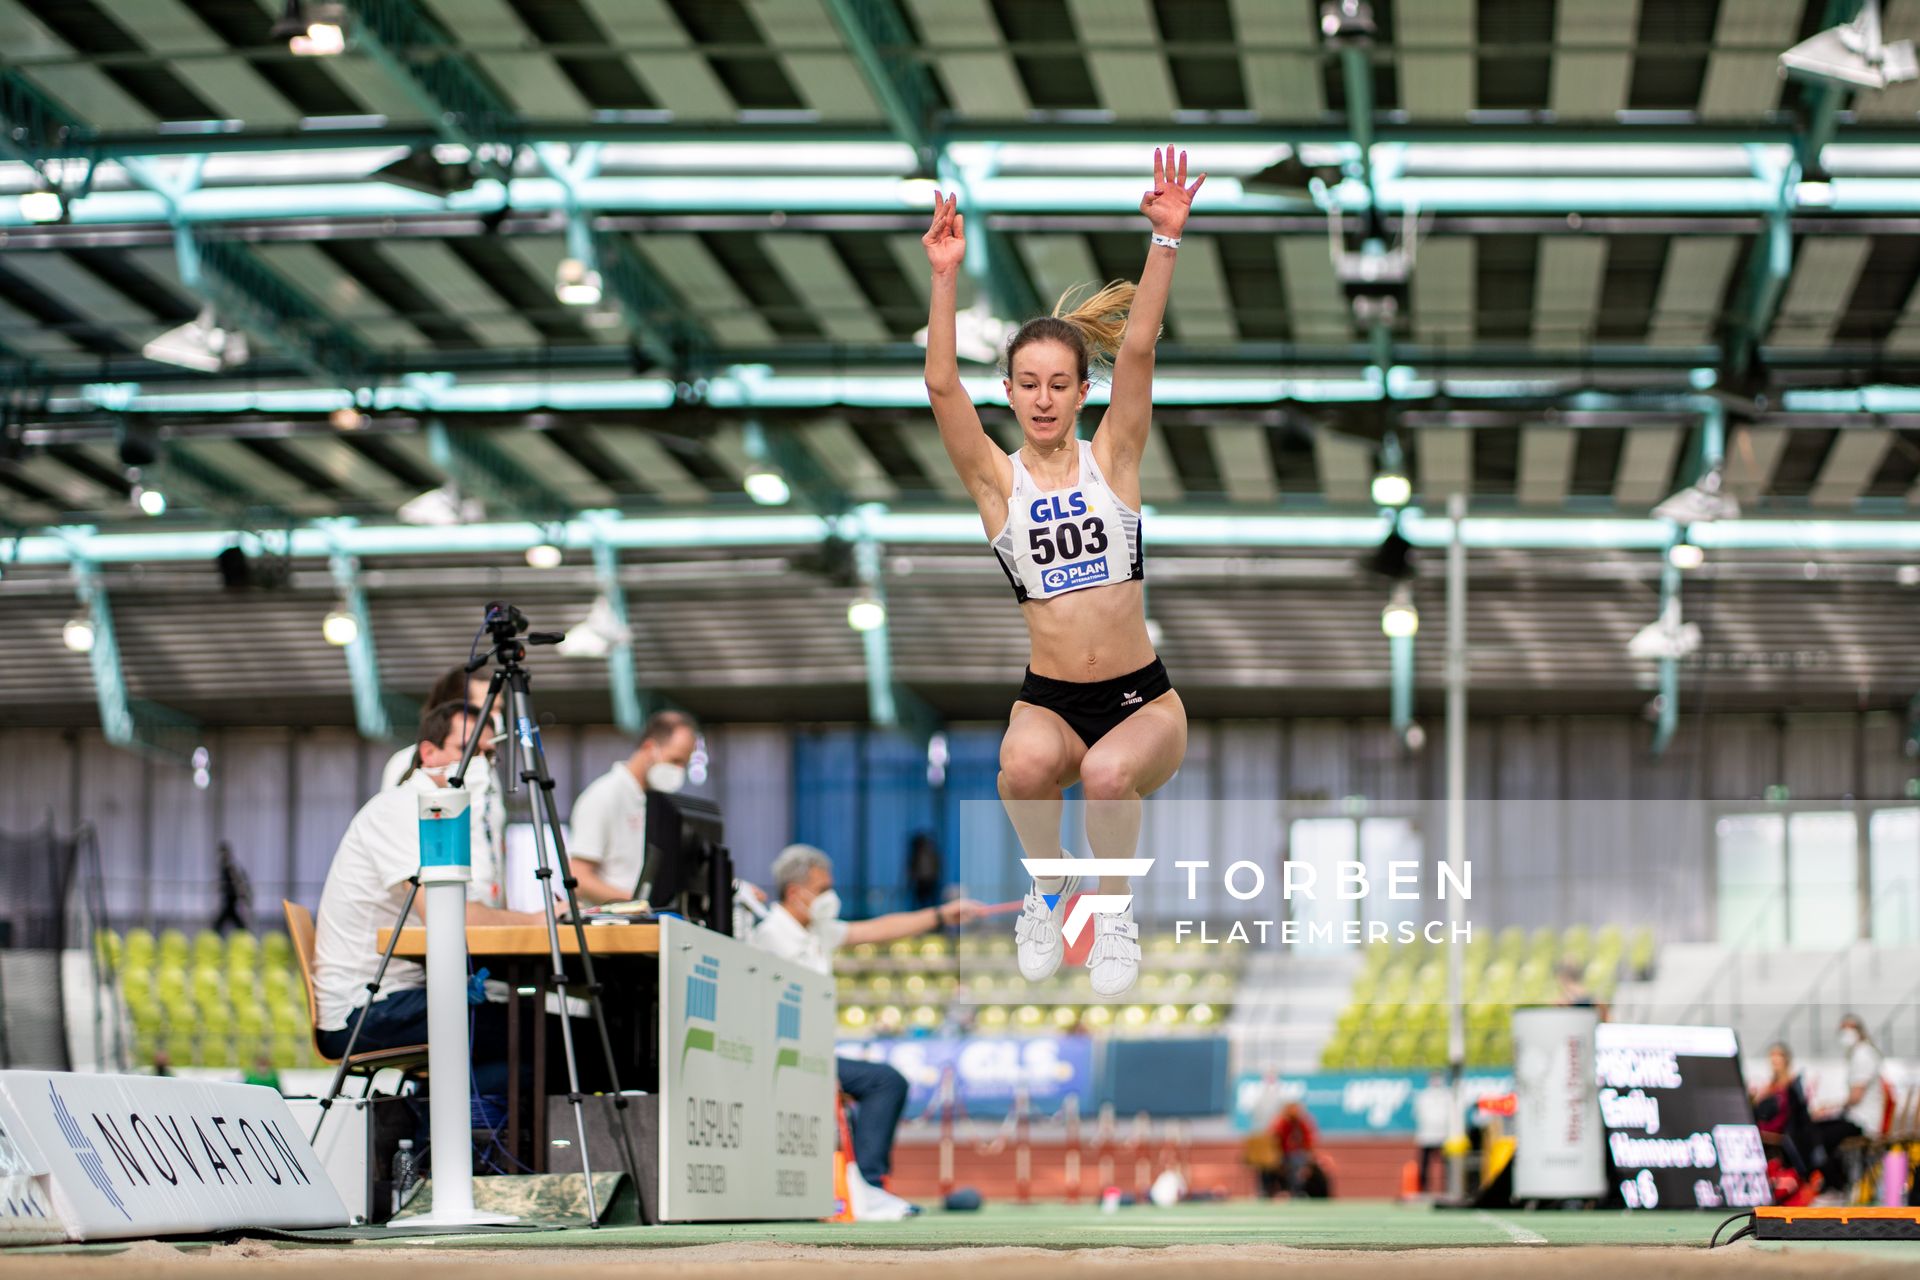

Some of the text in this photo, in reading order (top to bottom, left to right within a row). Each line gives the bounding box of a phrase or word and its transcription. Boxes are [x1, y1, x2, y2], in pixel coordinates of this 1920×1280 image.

[1028, 517, 1108, 565] 503
[1069, 561, 1105, 579] PLAN
[92, 1112, 311, 1187] NOVAFON
